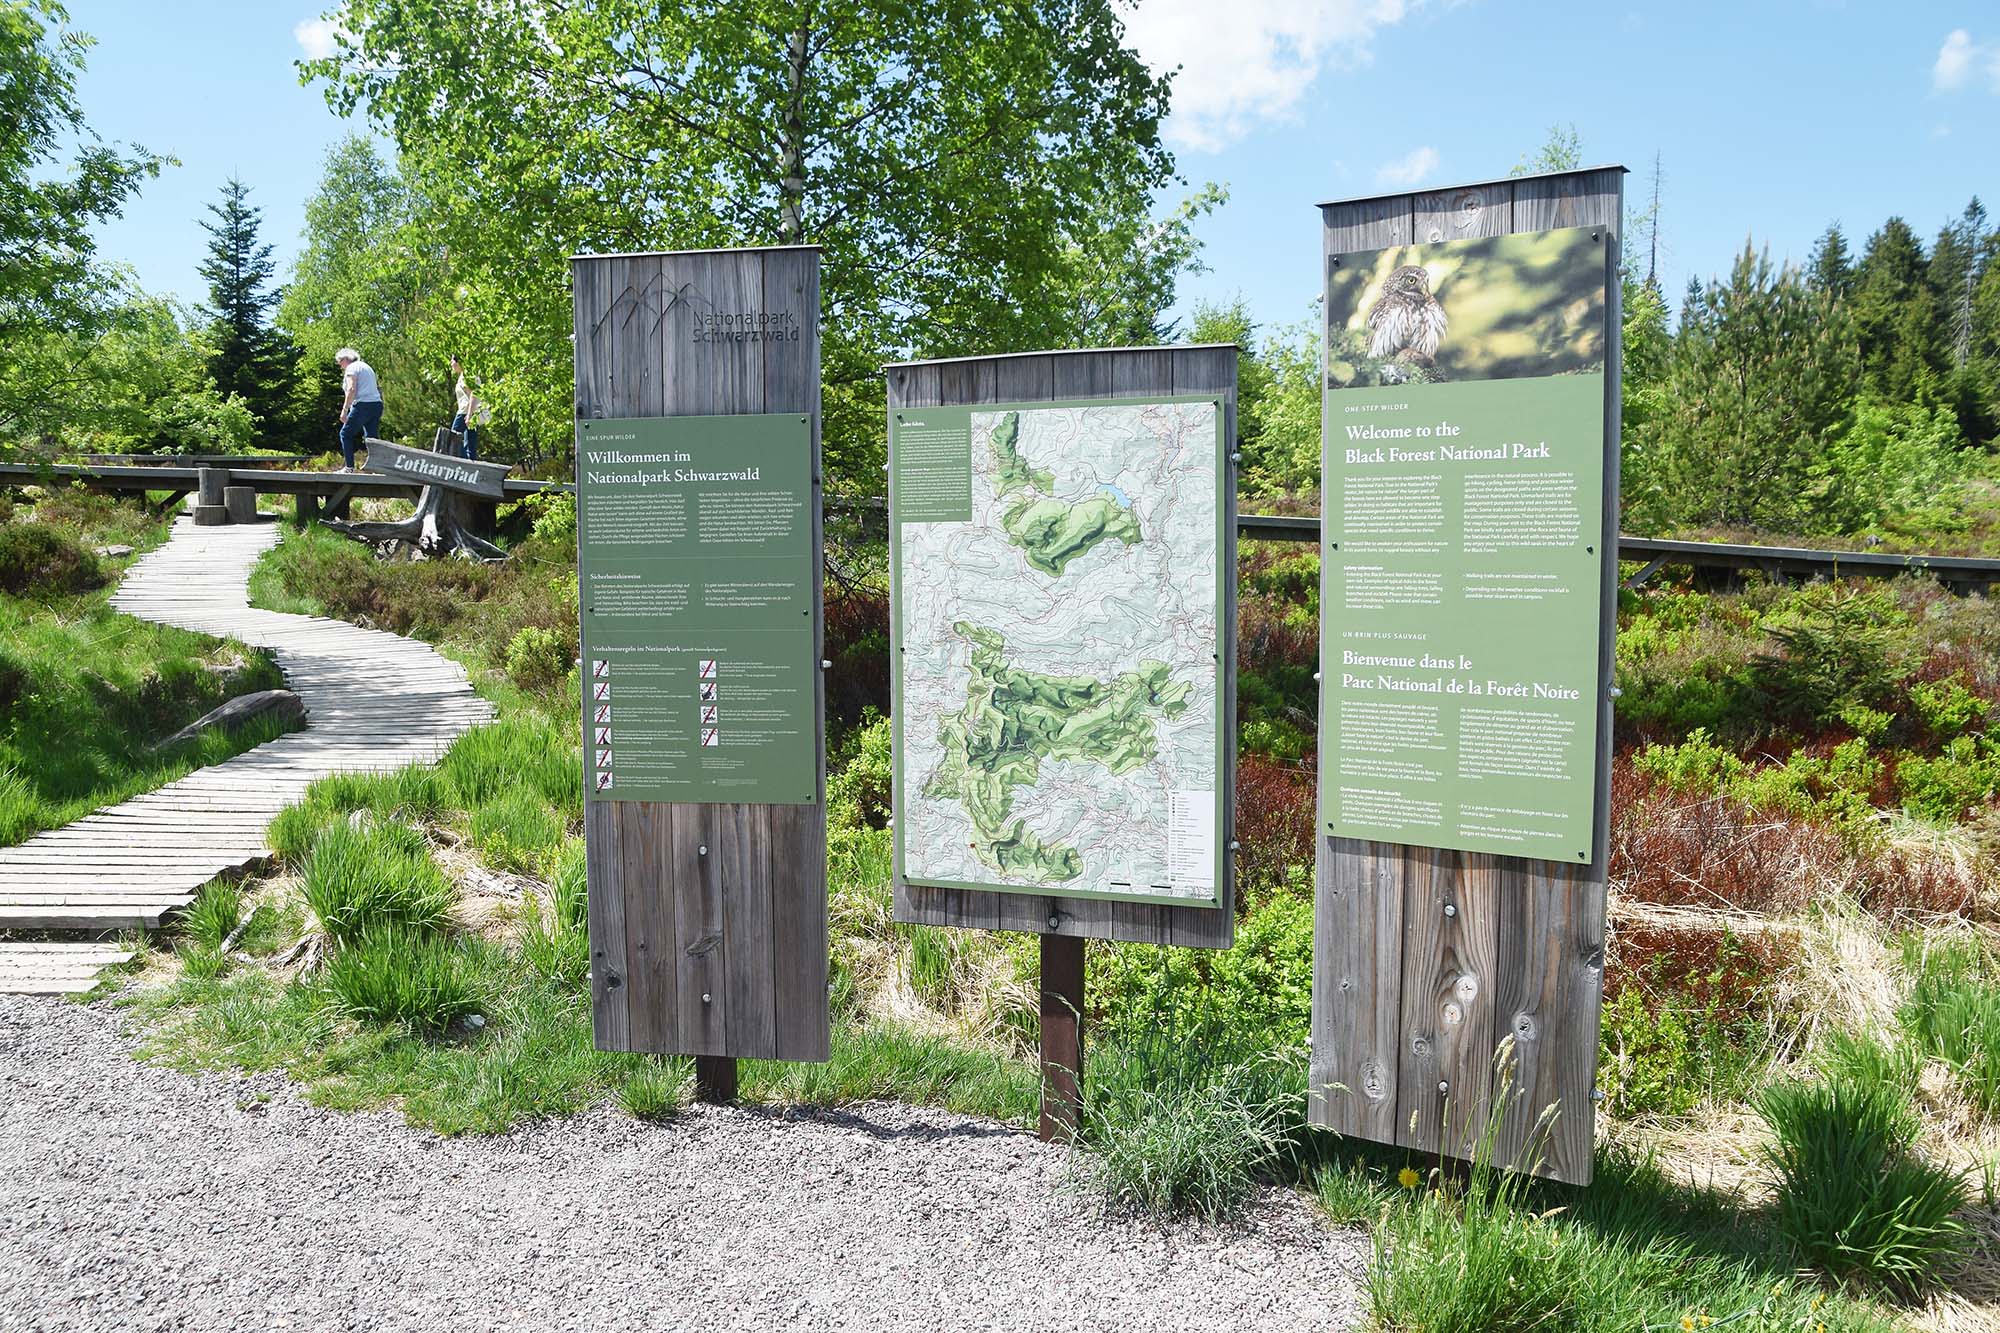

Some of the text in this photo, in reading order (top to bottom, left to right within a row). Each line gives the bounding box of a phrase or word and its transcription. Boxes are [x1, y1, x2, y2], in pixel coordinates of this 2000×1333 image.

[693, 309, 793, 326] Nationalpark
[692, 326, 800, 343] Schwarzwald
[1345, 403, 1408, 413] ONE STEP WILDER
[1345, 421, 1461, 440] Welcome to the
[587, 450, 691, 464] Willkommen im
[1345, 441, 1550, 464] Black Forest National Park
[394, 454, 480, 485] Lotharpfad
[587, 467, 760, 487] Nationalpark Schwarzwald
[1355, 631, 1372, 639] BRIN
[1394, 632, 1427, 640] SAUVAGE
[1343, 650, 1473, 670] Bienvenue dans le
[1342, 673, 1580, 699] Parc National de la Forêt Noire
